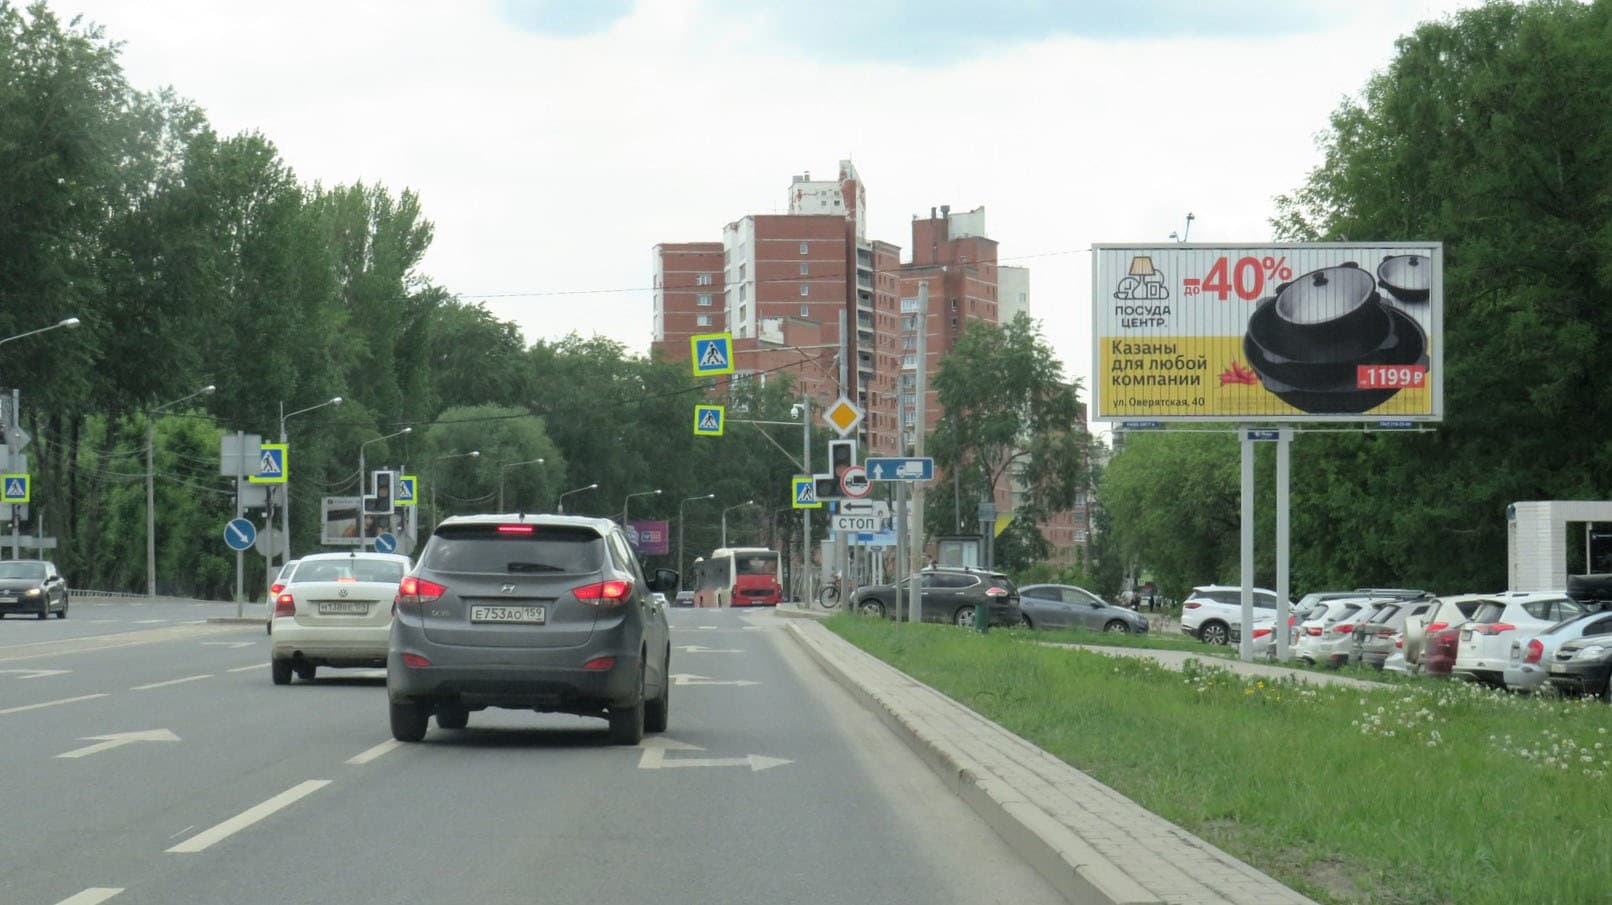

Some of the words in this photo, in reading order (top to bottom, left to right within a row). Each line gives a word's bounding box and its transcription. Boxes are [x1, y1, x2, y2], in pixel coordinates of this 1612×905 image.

[1184, 286, 1200, 296] до
[1115, 305, 1171, 317] ПОСУДА
[1112, 340, 1176, 355] Казаны
[1111, 358, 1144, 372] для
[1149, 354, 1207, 370] любой
[1112, 375, 1201, 386] компании
[1113, 399, 1126, 408] ул.
[1192, 396, 1205, 406] 40
[839, 518, 874, 529] СТОП
